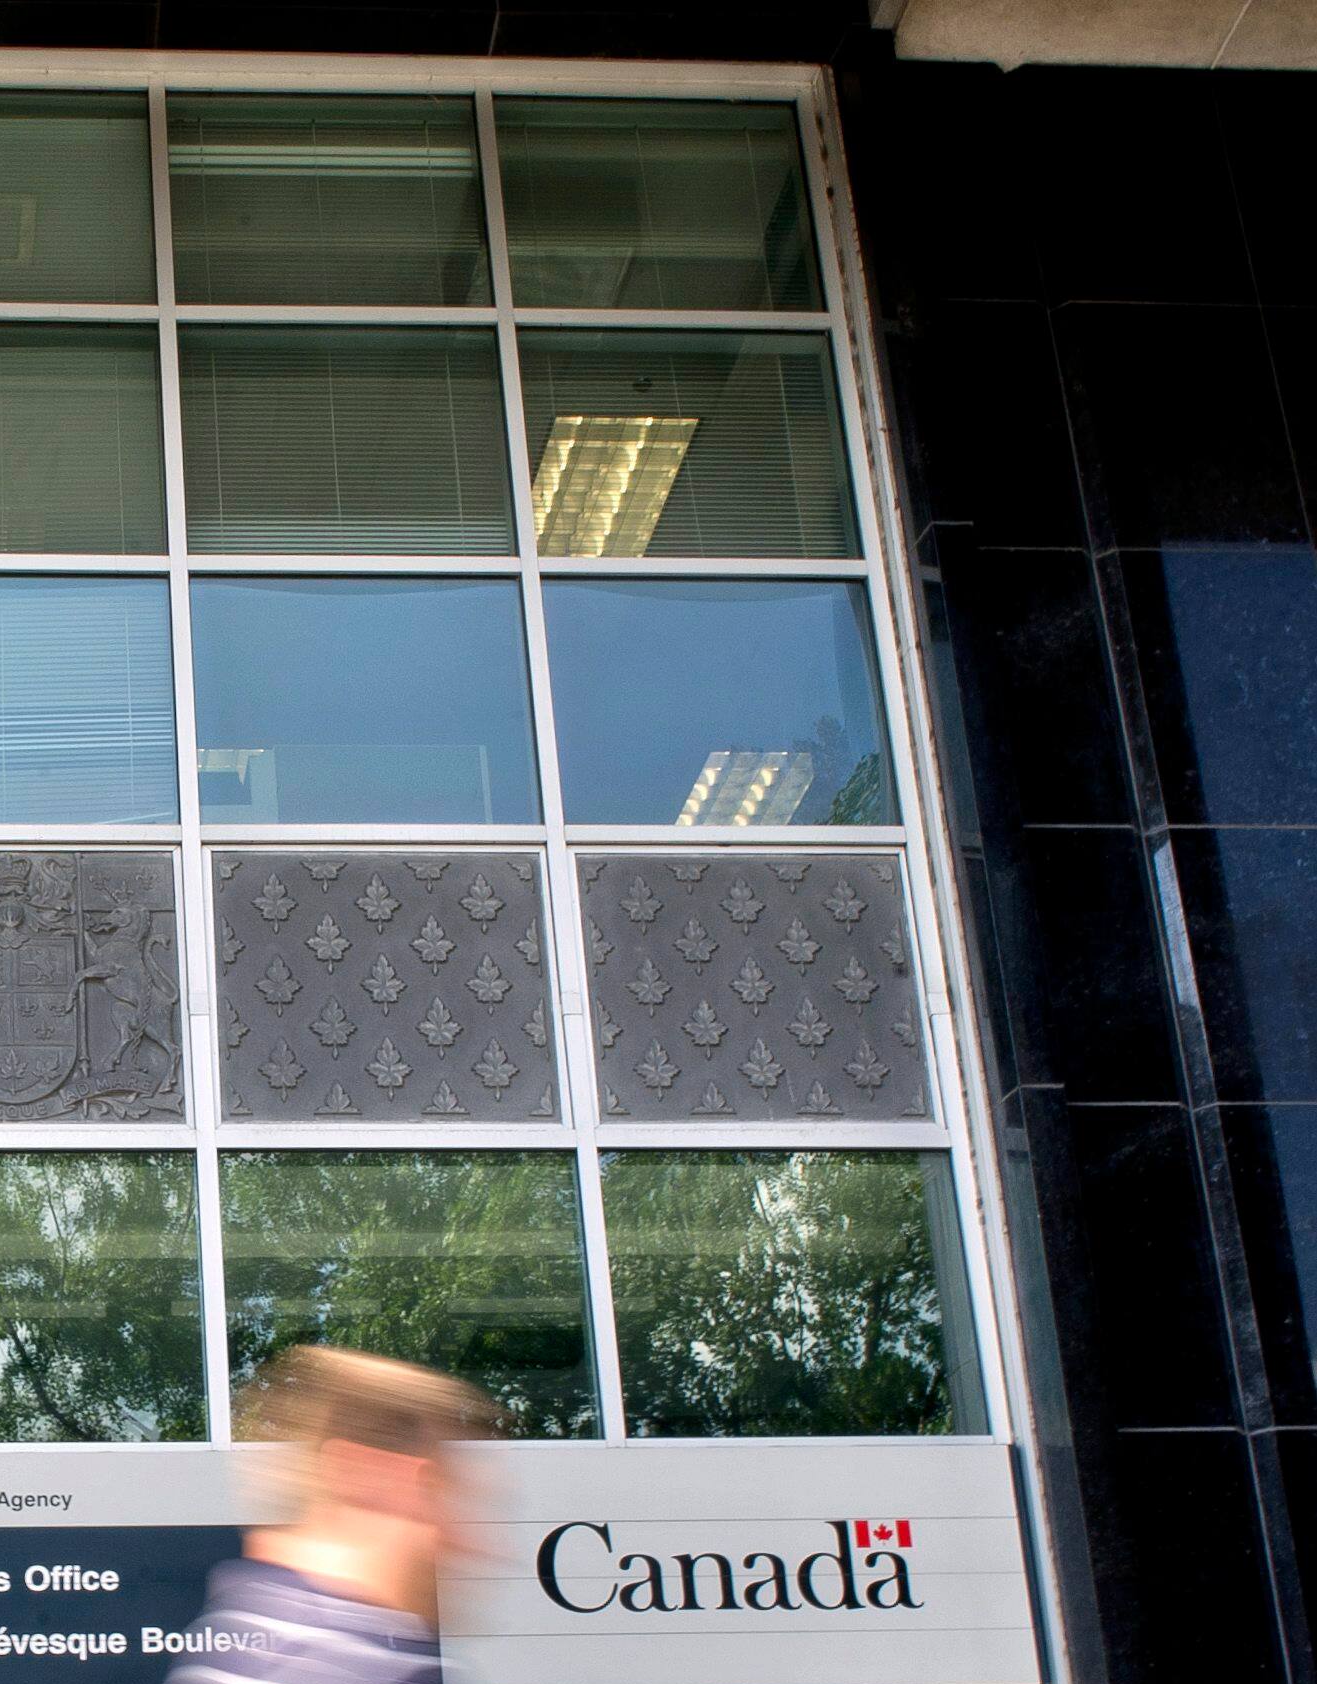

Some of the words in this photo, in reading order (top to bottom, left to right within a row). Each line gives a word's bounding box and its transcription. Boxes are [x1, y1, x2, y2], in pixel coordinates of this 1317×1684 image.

[66, 1082, 89, 1102] AD
[96, 1077, 152, 1092] MARE
[24, 1564, 120, 1592] Office
[536, 1520, 925, 1614] Canada
